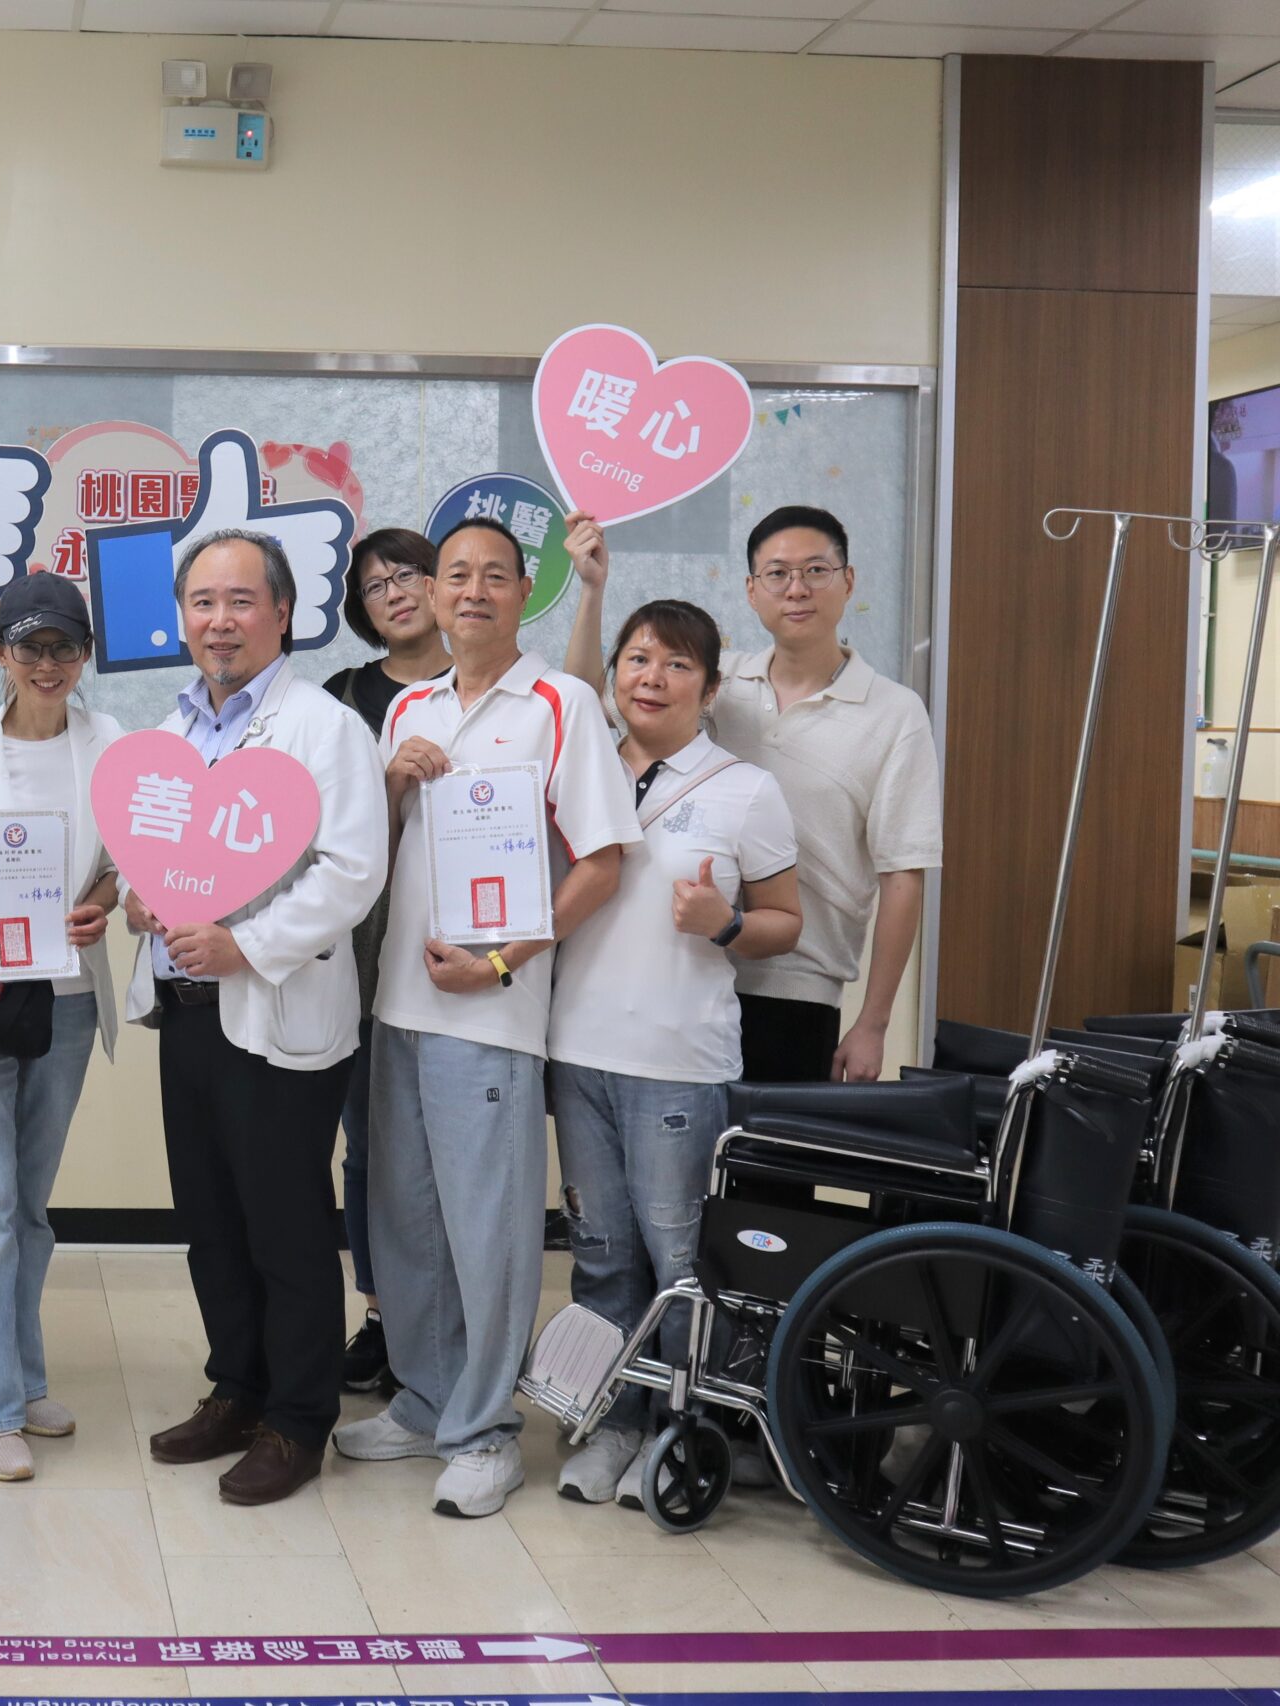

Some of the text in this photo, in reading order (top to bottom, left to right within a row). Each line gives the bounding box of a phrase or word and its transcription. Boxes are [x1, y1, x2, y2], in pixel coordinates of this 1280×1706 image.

[567, 369, 701, 460] 暖心
[578, 450, 645, 493] Caring
[128, 773, 274, 853] 善心
[164, 868, 215, 895] Kind
[40, 1652, 137, 1662] Physical
